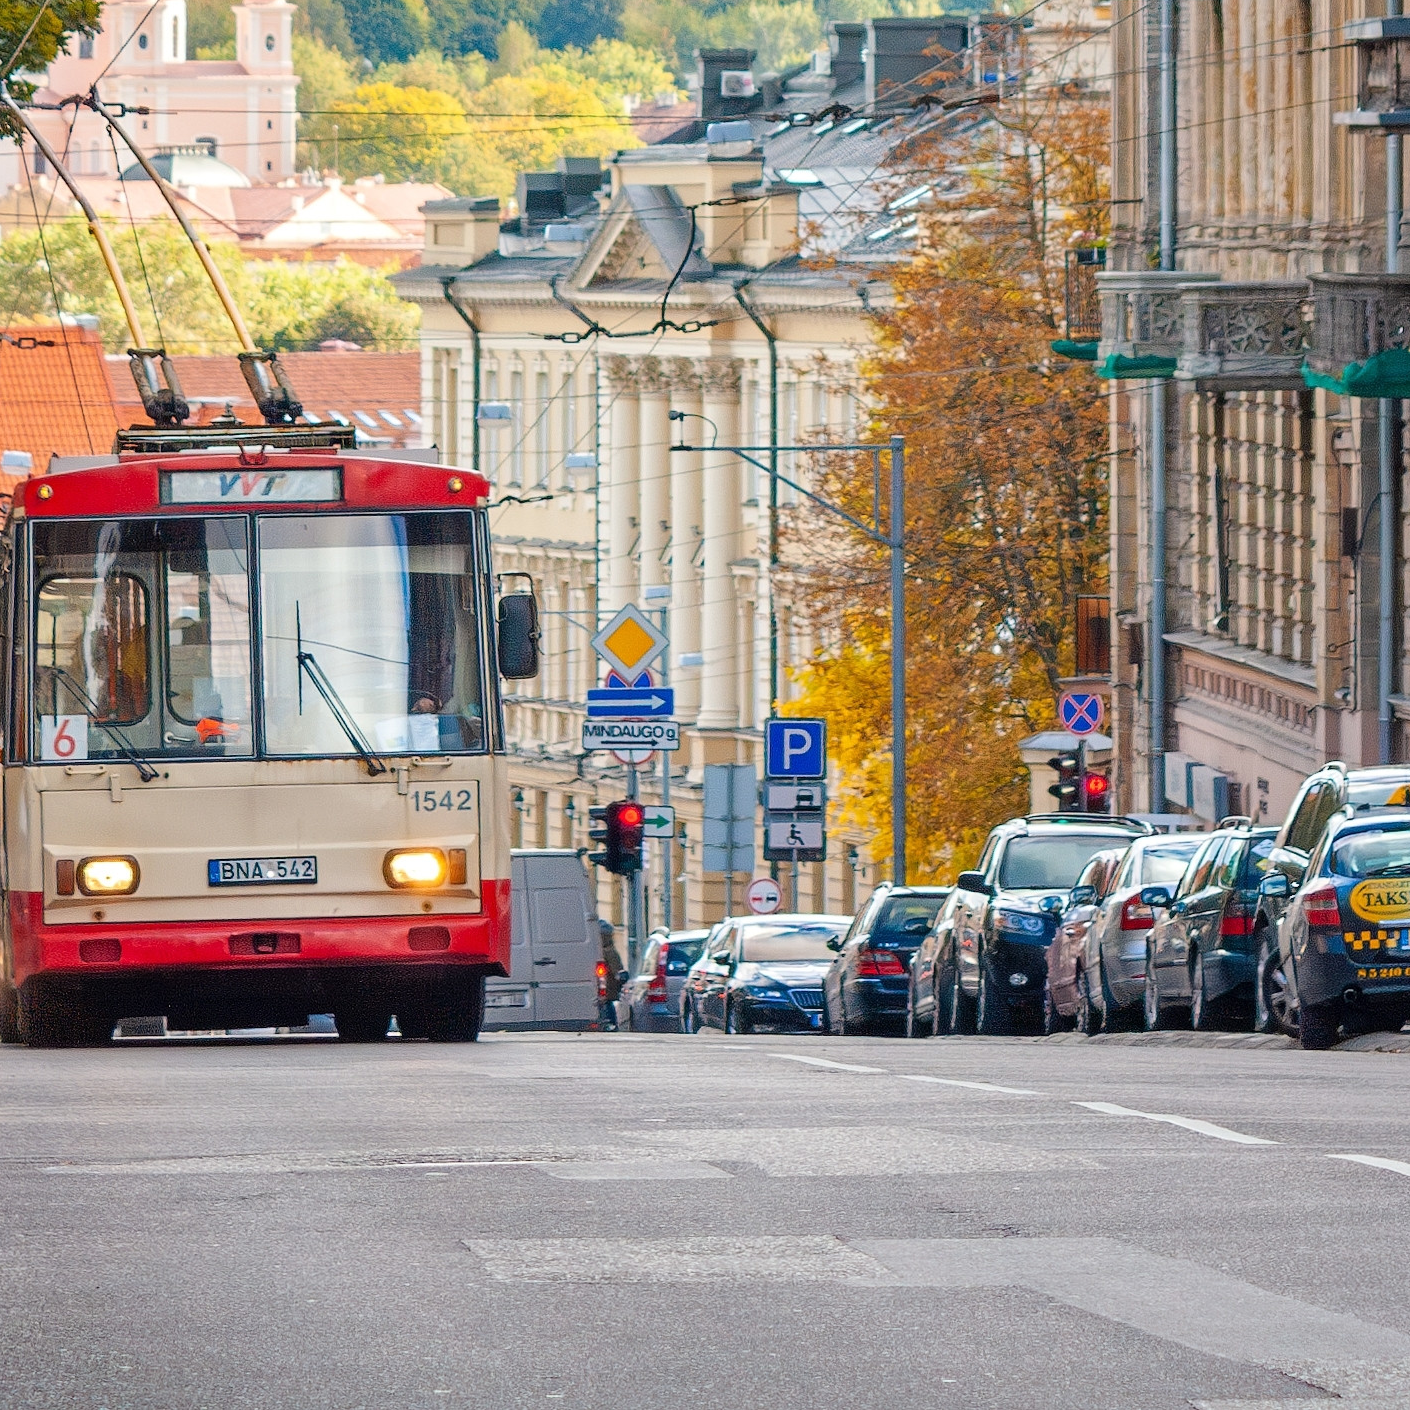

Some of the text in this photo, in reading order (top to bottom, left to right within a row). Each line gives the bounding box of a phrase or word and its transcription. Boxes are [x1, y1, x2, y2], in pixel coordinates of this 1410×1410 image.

[220, 473, 287, 496] VVT
[53, 719, 76, 758] 6
[584, 725, 664, 739] MINDAUGO
[783, 728, 812, 770] P
[411, 789, 472, 812] 1542
[221, 862, 264, 880] BNA
[277, 859, 314, 878] 542
